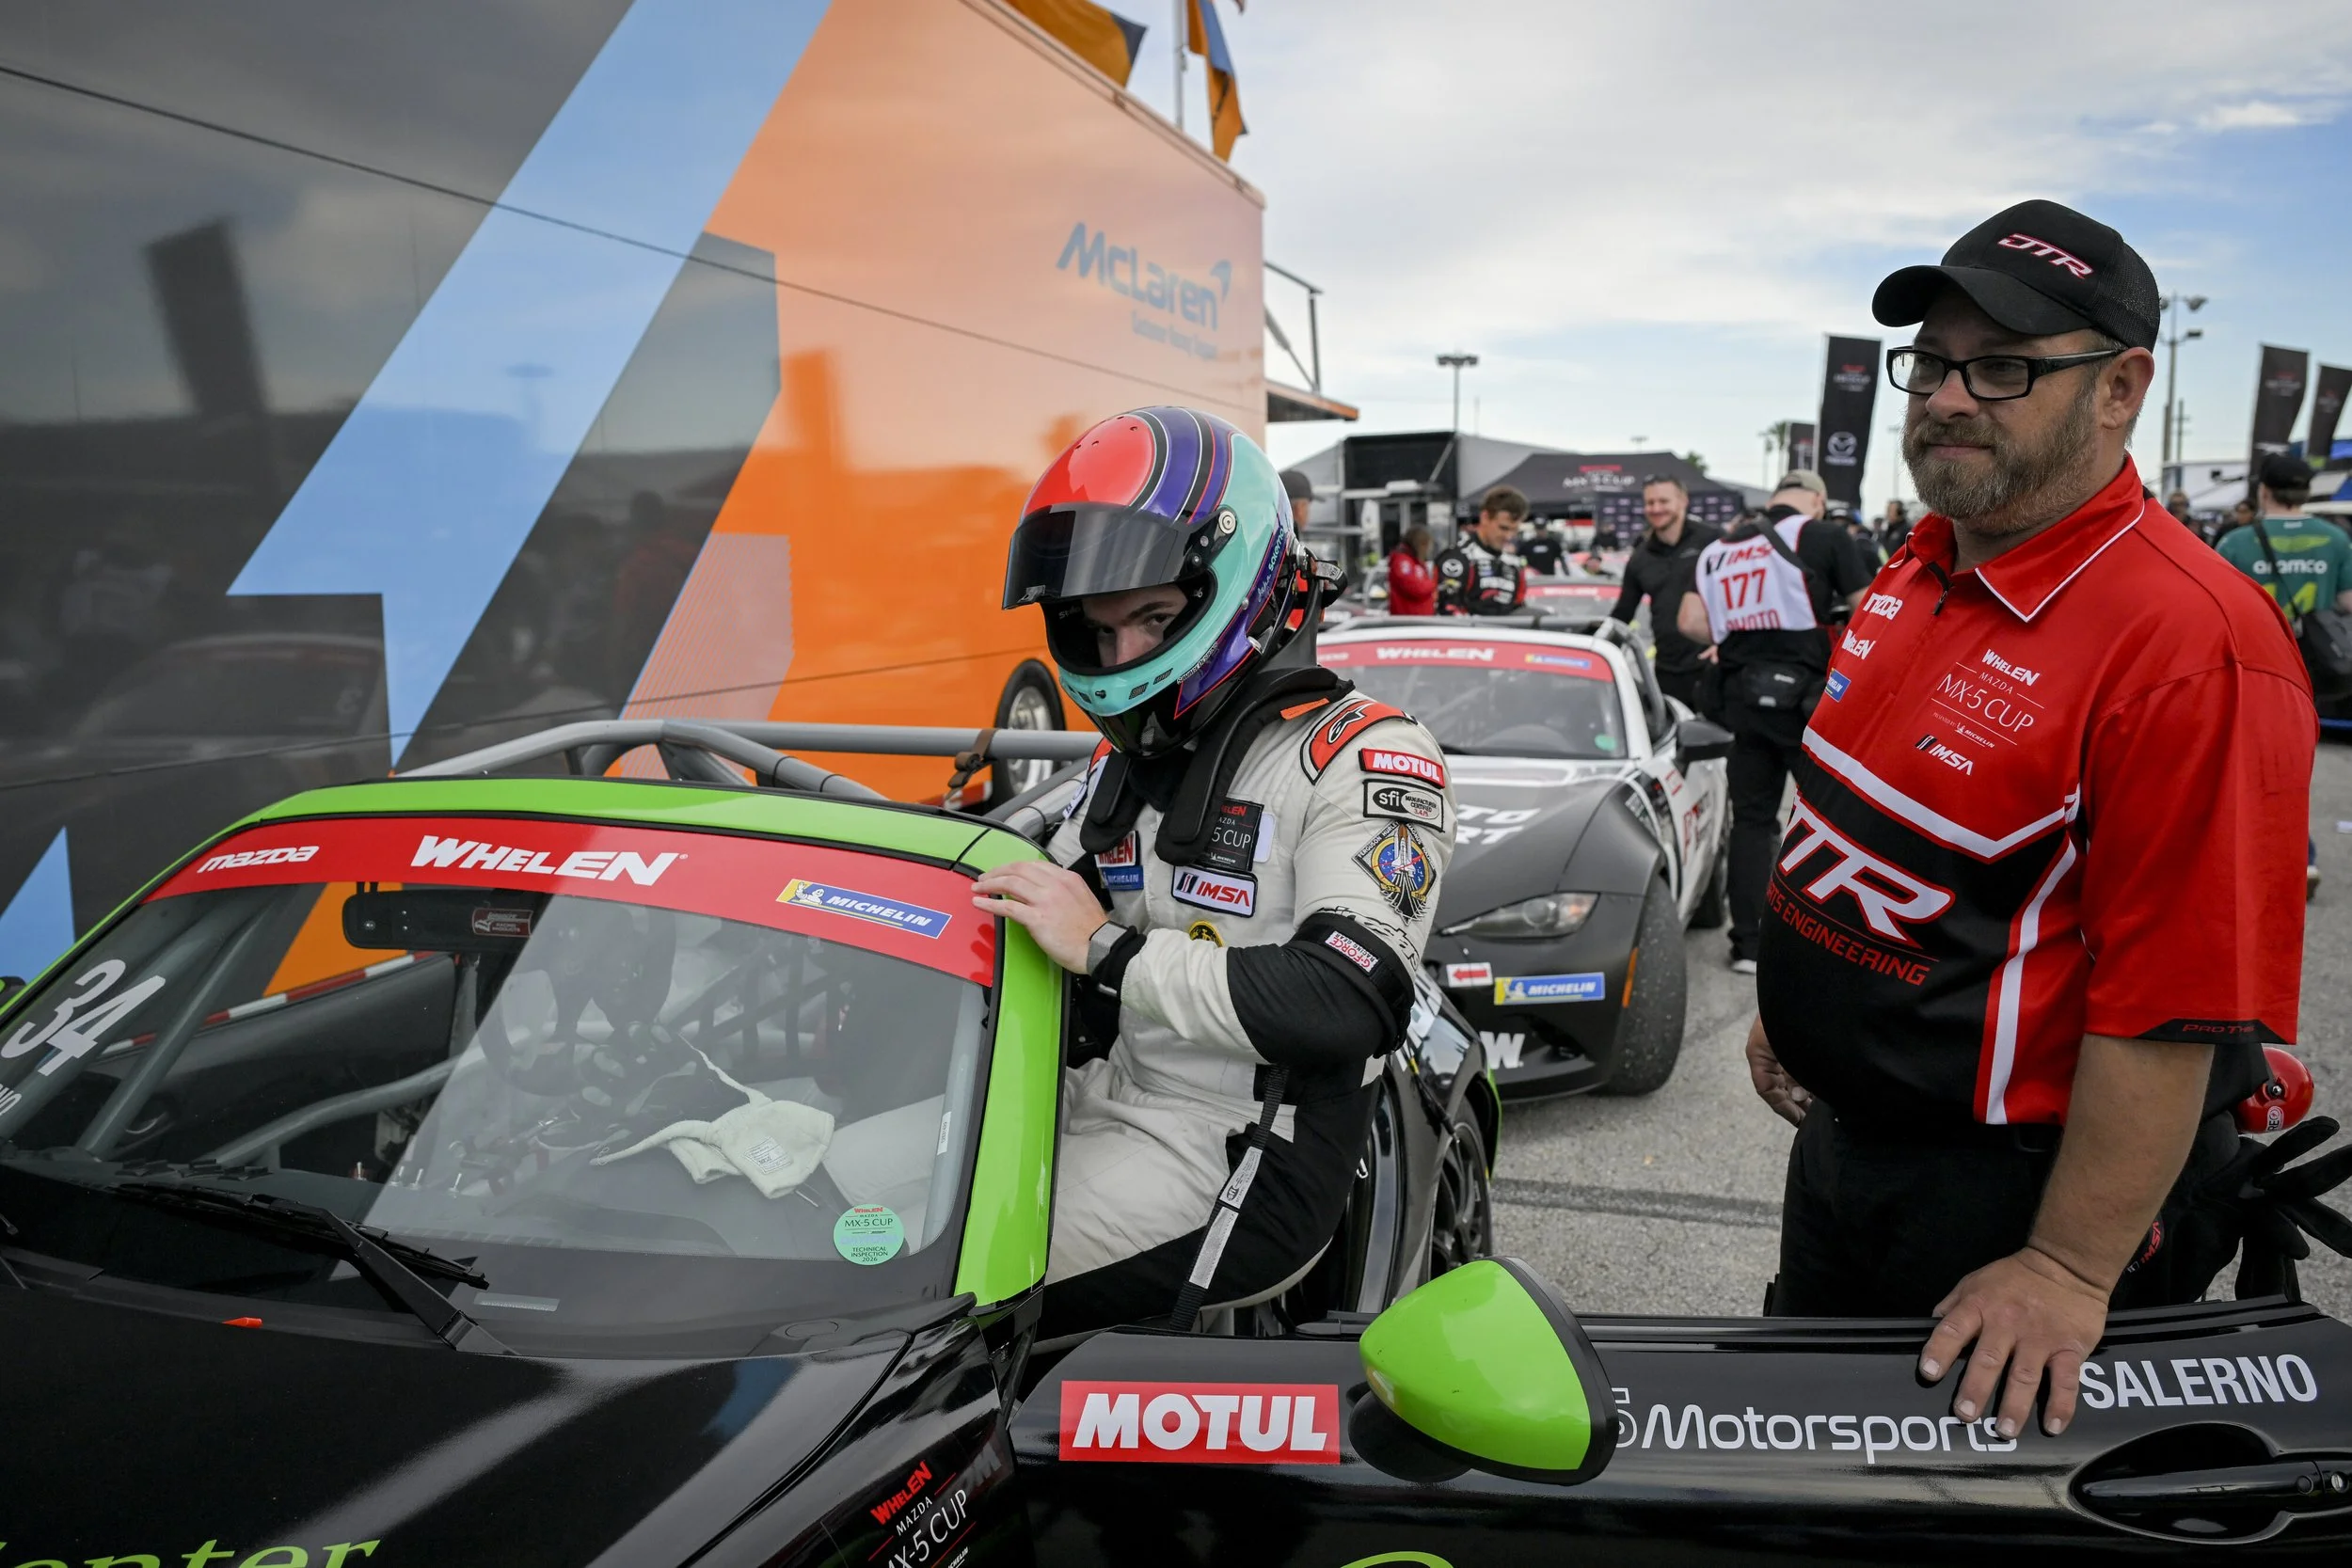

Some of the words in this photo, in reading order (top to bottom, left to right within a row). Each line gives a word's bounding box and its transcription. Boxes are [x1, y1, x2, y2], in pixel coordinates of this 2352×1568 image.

[1996, 232, 2094, 279] JTR
[1056, 222, 1217, 330] McLaren
[1726, 544, 1773, 565] IMS
[1720, 567, 1768, 610] 177
[1375, 646, 1496, 662] WHELEN
[1981, 648, 2041, 687] WHELEN
[1936, 673, 1988, 709] MX-5
[1984, 698, 2034, 733] CUP
[1979, 672, 2014, 695] MAZDA
[1963, 729, 1995, 749] MICHELIN
[1372, 752, 1440, 782] MOTUL
[1928, 743, 1974, 776] IMSA
[1378, 790, 1400, 807] sfi
[1218, 816, 1236, 826] AZDA
[1222, 829, 1251, 849] CUP
[197, 846, 320, 874] mazda
[410, 834, 680, 886] WHELEN
[1779, 794, 1955, 948] TR
[826, 895, 933, 927] MICHELIN
[1196, 880, 1250, 907] IMSA
[1782, 899, 1931, 987] ENGINEERING
[1527, 981, 1597, 996] MICHELIN
[1, 958, 167, 1077] 34
[845, 1218, 870, 1227] MX-5
[872, 1218, 894, 1227] CUP
[2078, 1354, 2318, 1409] SALERNO
[1072, 1392, 1328, 1452] MOTUL
[1640, 1403, 2018, 1465] Motorsports
[869, 1460, 933, 1526] WHELEN
[896, 1496, 933, 1536] MAZDA
[930, 1489, 968, 1544] CUP
